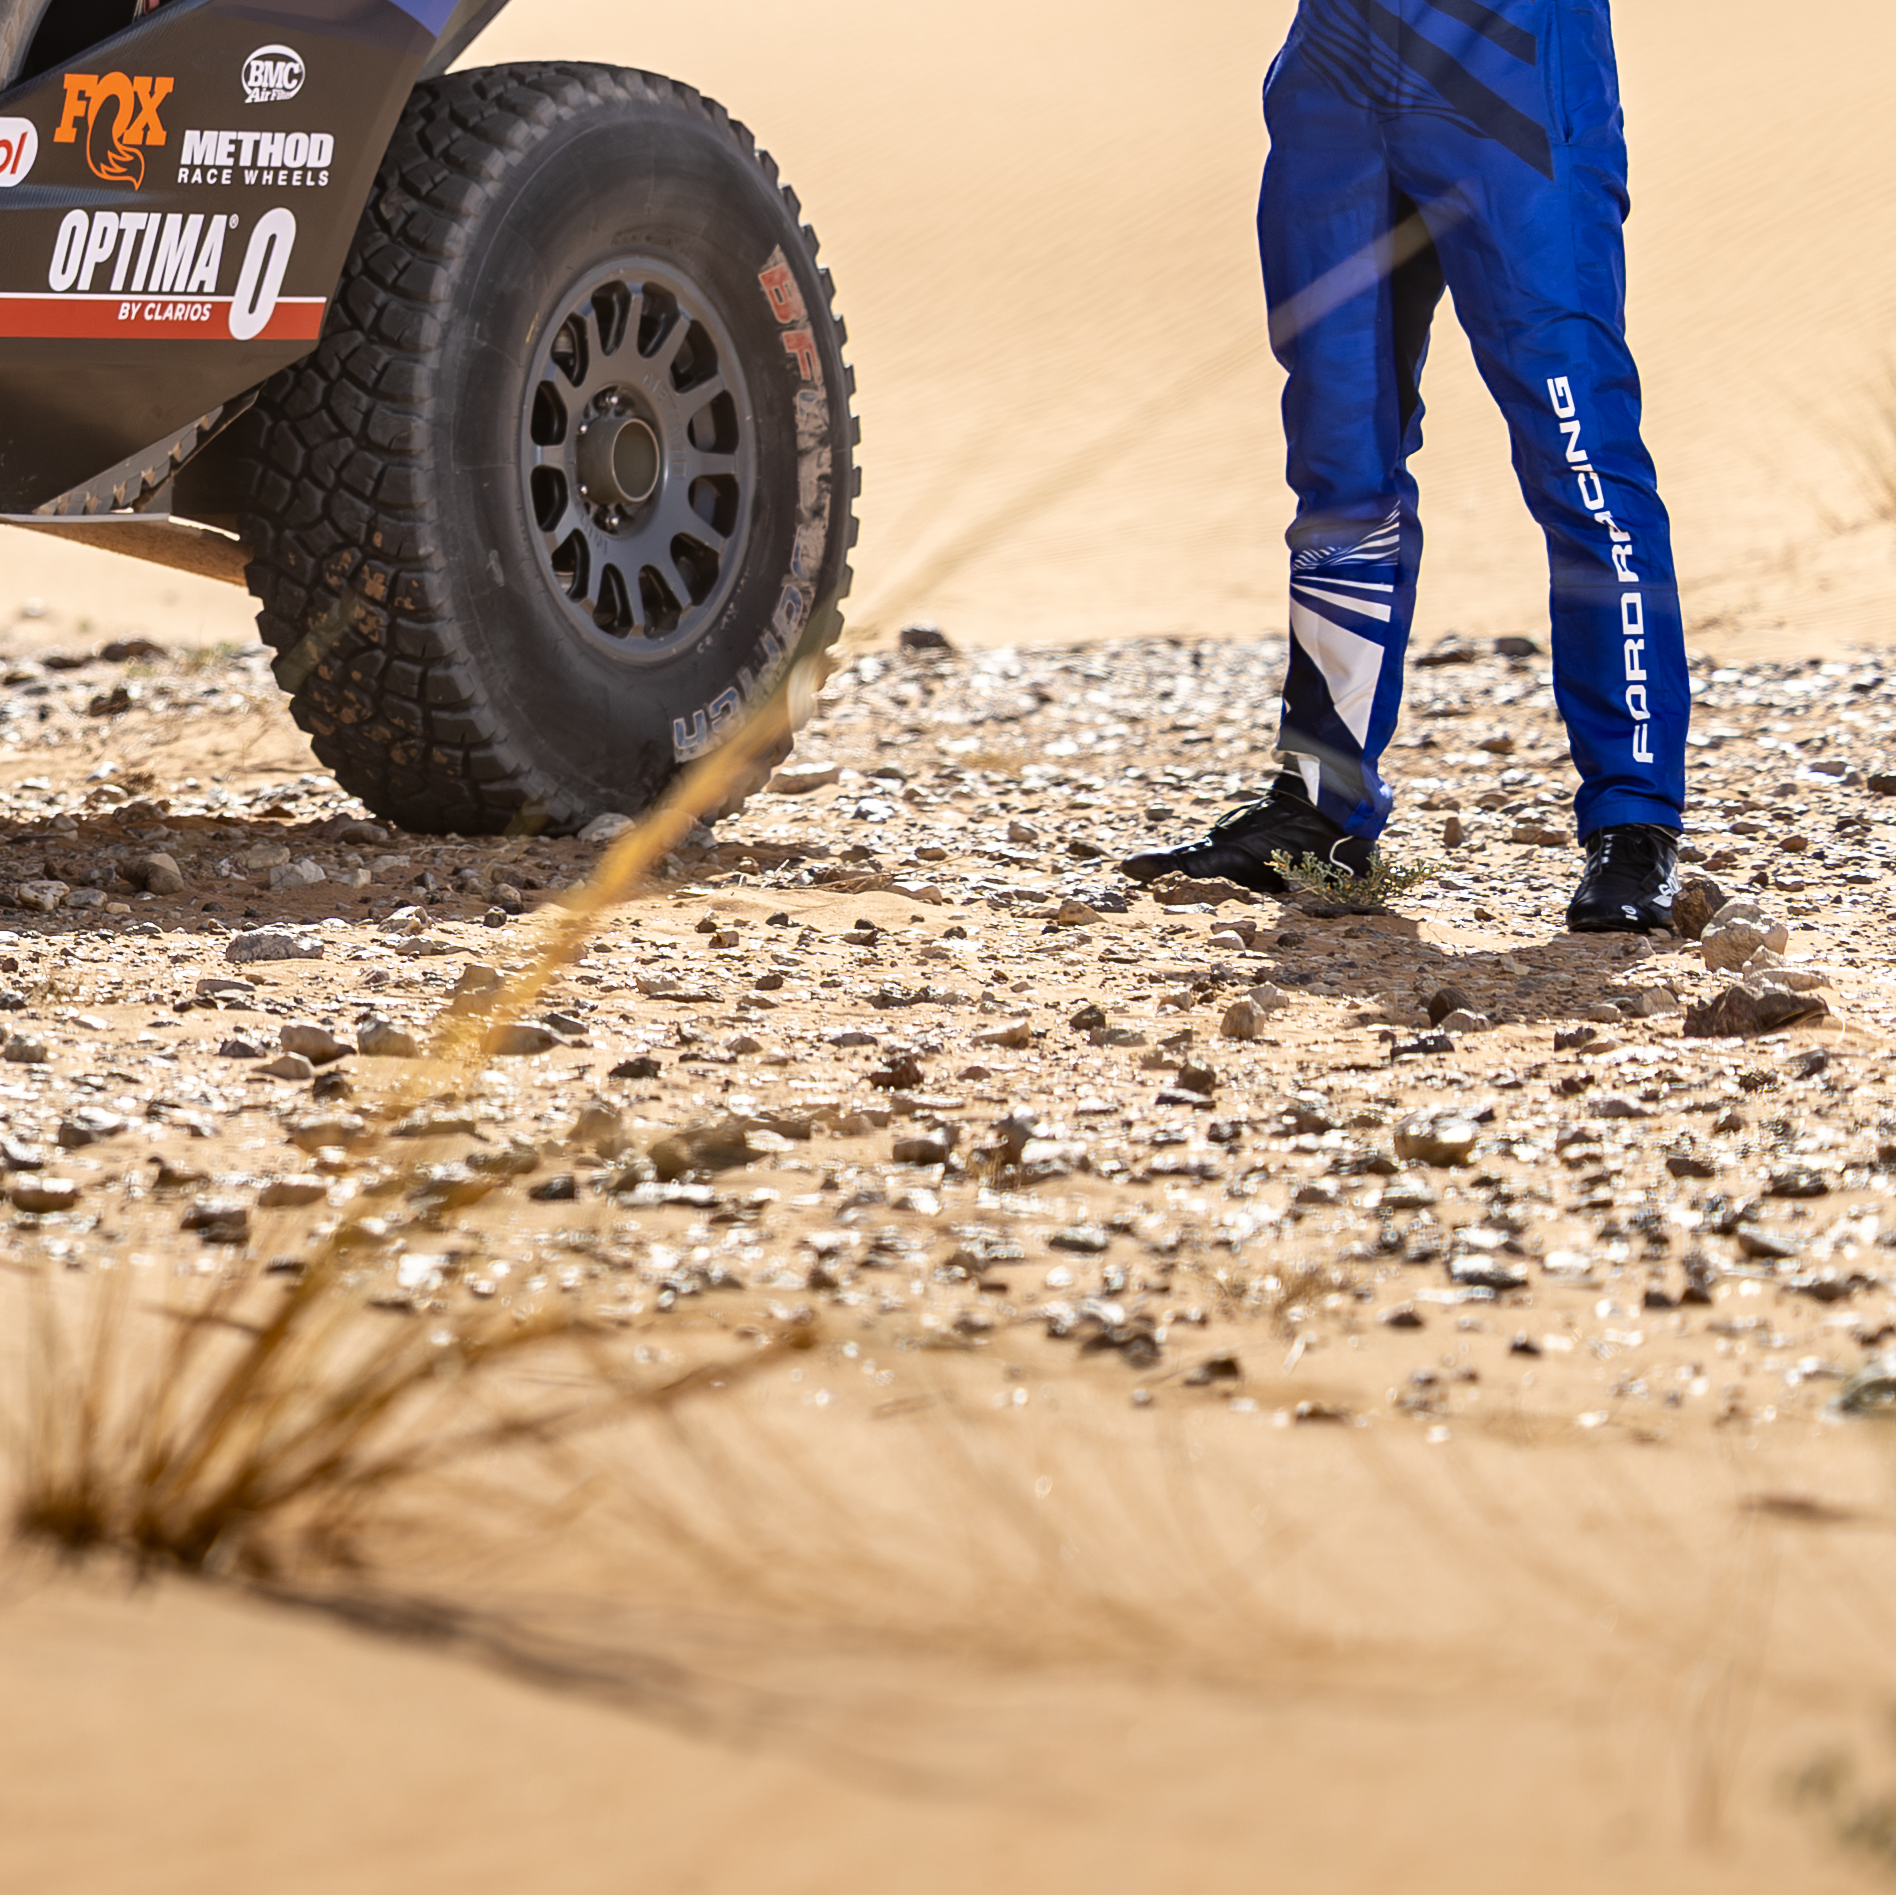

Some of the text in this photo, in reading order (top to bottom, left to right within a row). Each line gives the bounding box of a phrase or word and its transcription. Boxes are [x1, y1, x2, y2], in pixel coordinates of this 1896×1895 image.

[248, 59, 302, 90] BMC
[245, 88, 268, 104] Air
[53, 71, 175, 166] FOX
[180, 130, 335, 169] METHOD
[177, 168, 329, 186] RACE WHEELS
[118, 302, 212, 322] BY CLARIOS
[1547, 376, 1655, 764] FORD RACING
